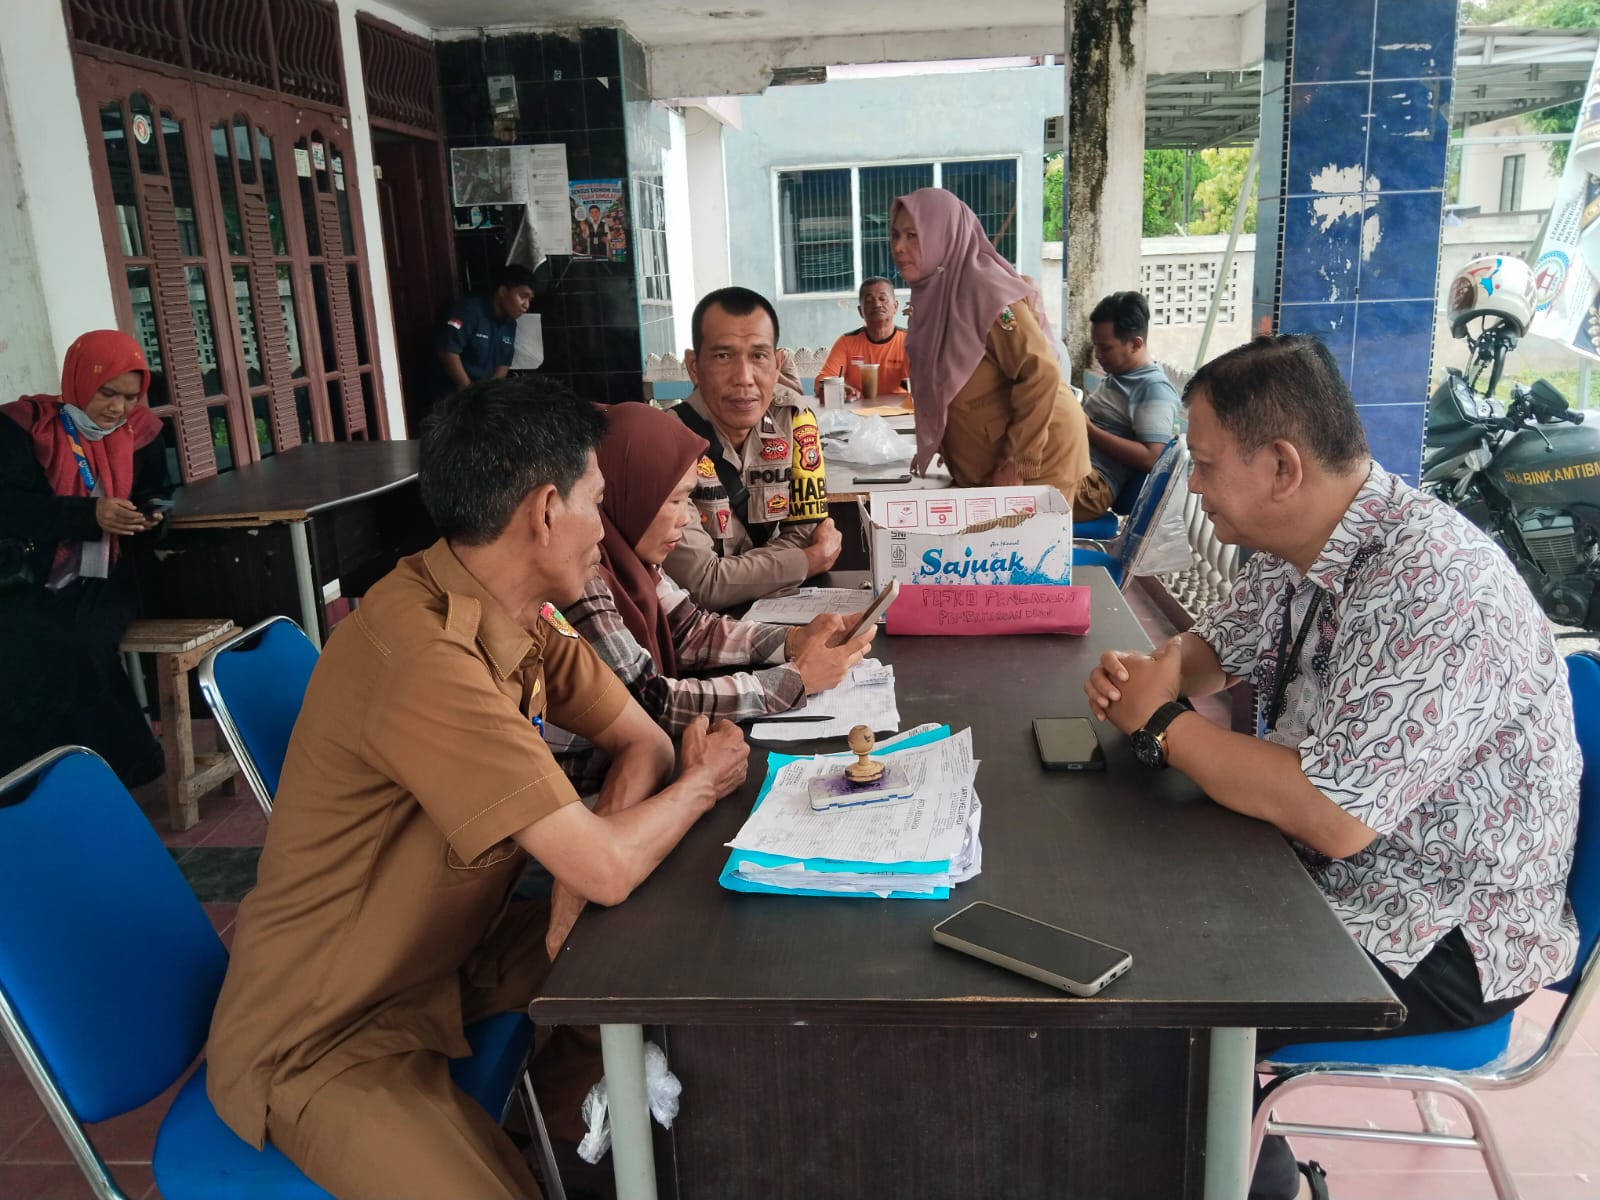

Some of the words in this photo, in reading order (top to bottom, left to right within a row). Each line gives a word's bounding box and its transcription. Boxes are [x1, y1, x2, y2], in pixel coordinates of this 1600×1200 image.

[788, 477, 828, 502] HAB
[787, 500, 829, 517] AMTIB
[921, 546, 1024, 578] Sajuak
